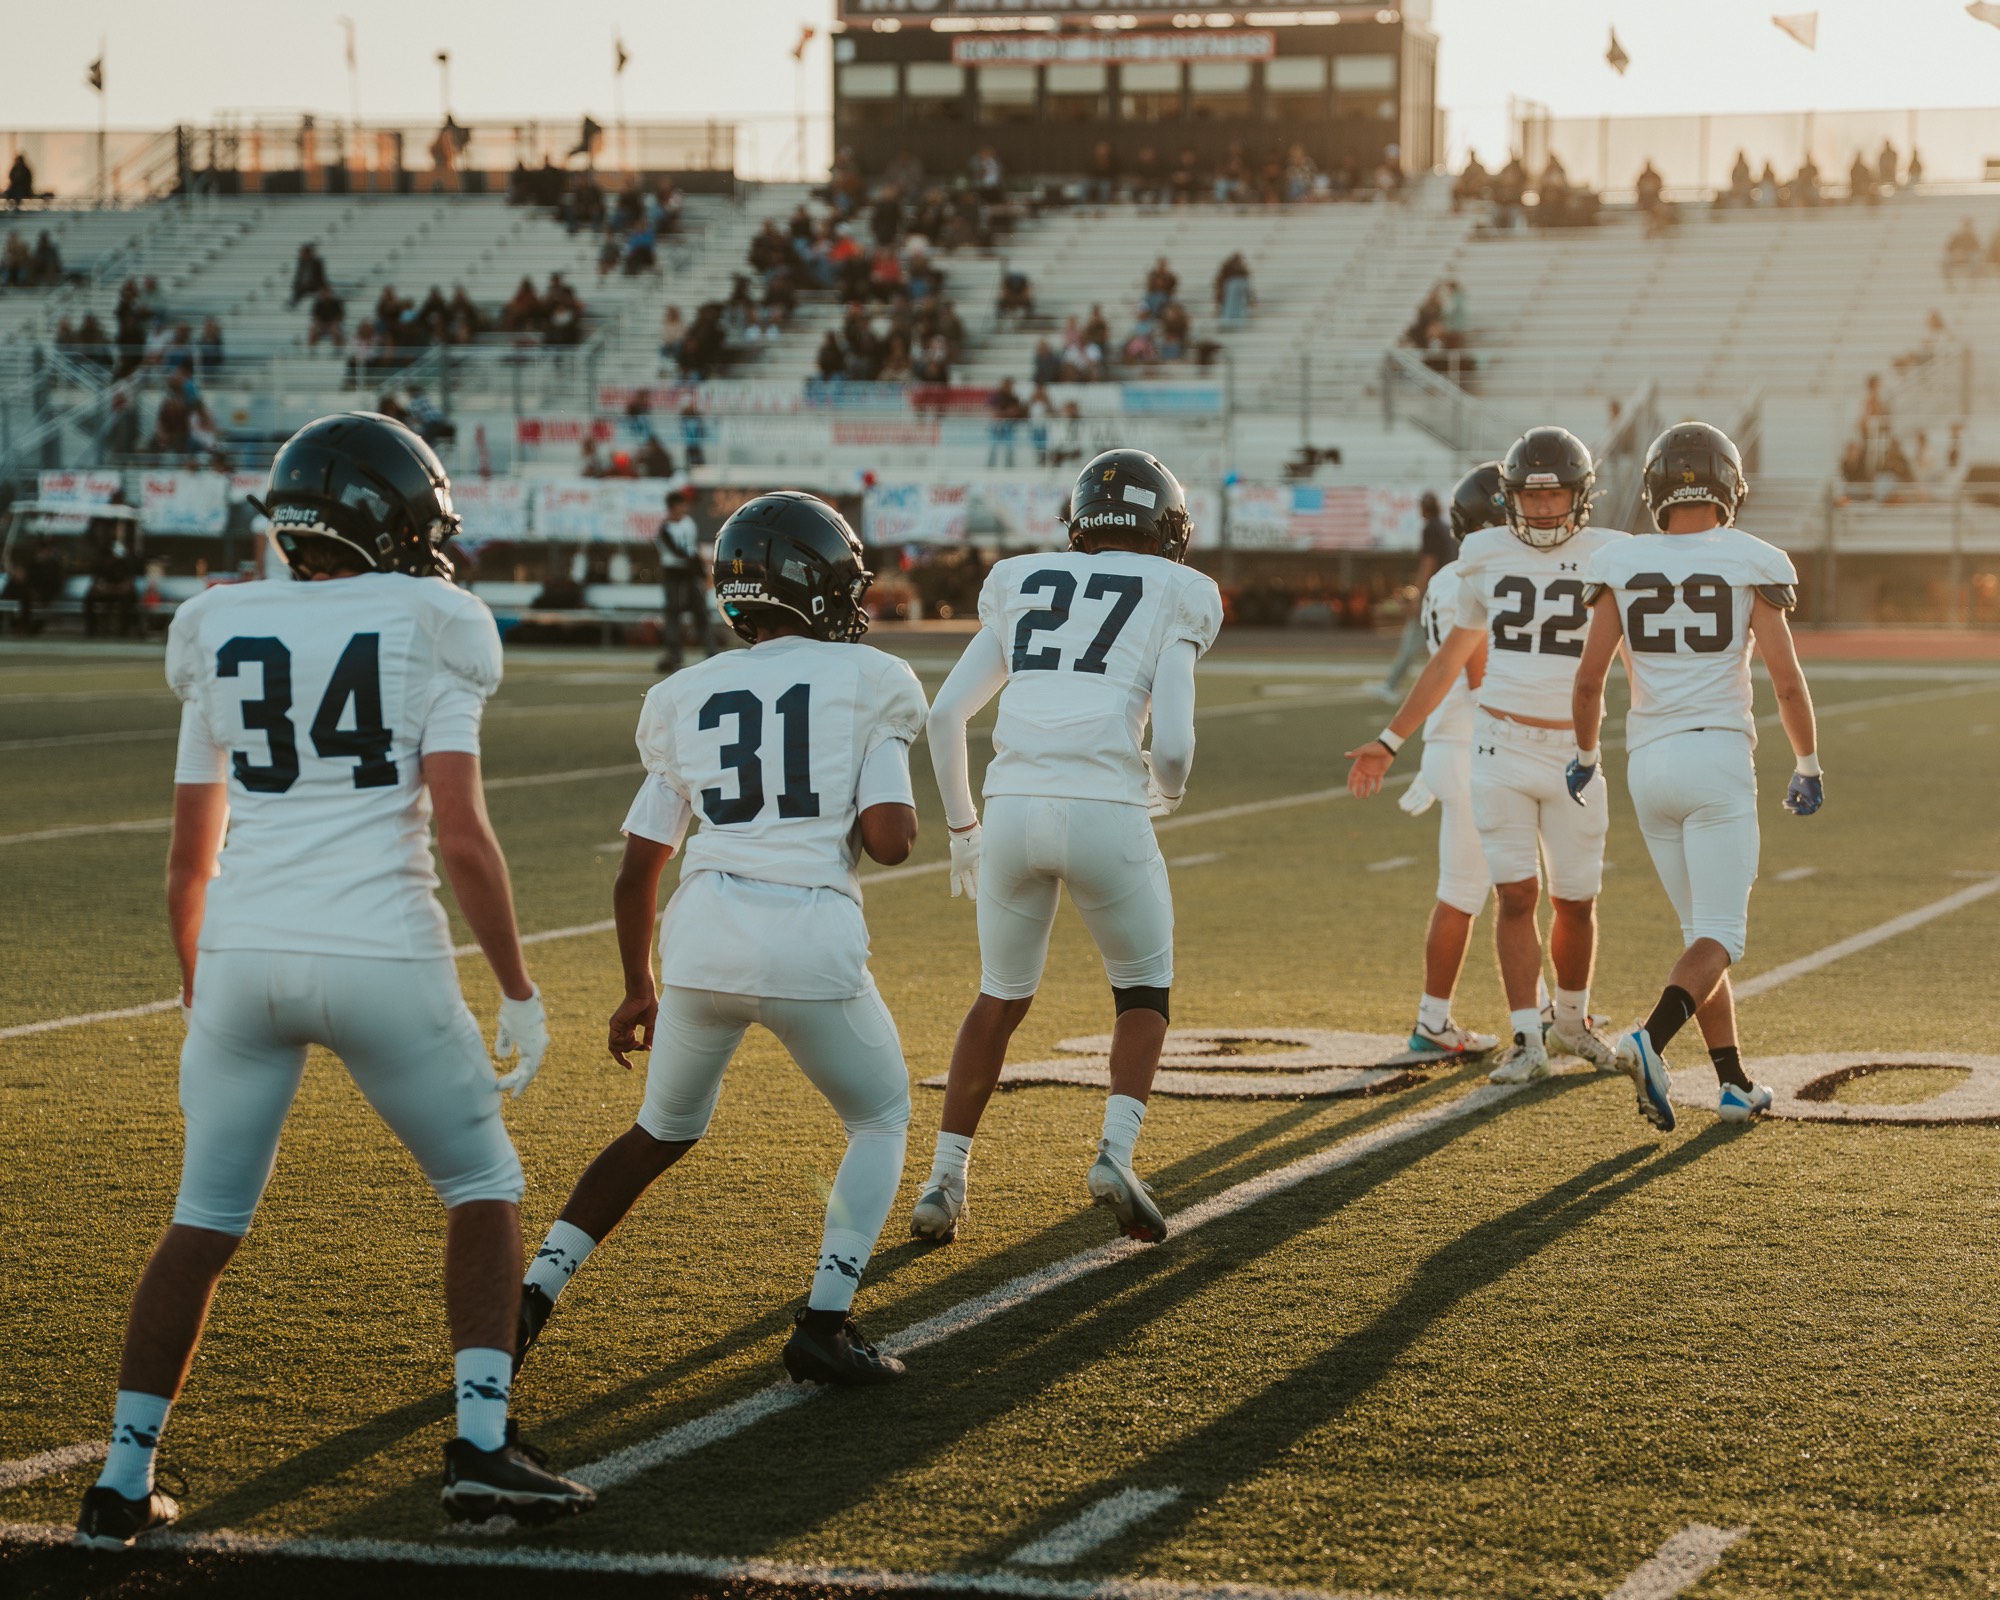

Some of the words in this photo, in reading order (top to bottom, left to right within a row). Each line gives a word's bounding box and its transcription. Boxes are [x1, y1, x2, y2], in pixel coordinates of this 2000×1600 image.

[1103, 469, 1117, 481] 27
[1079, 512, 1137, 529] Riddell
[722, 580, 763, 594] schutt
[732, 559, 744, 575] 31
[1012, 569, 1143, 674] 27
[1492, 575, 1588, 658] 22
[1625, 572, 1733, 654] 29
[216, 632, 398, 793] 34
[698, 683, 820, 825] 31
